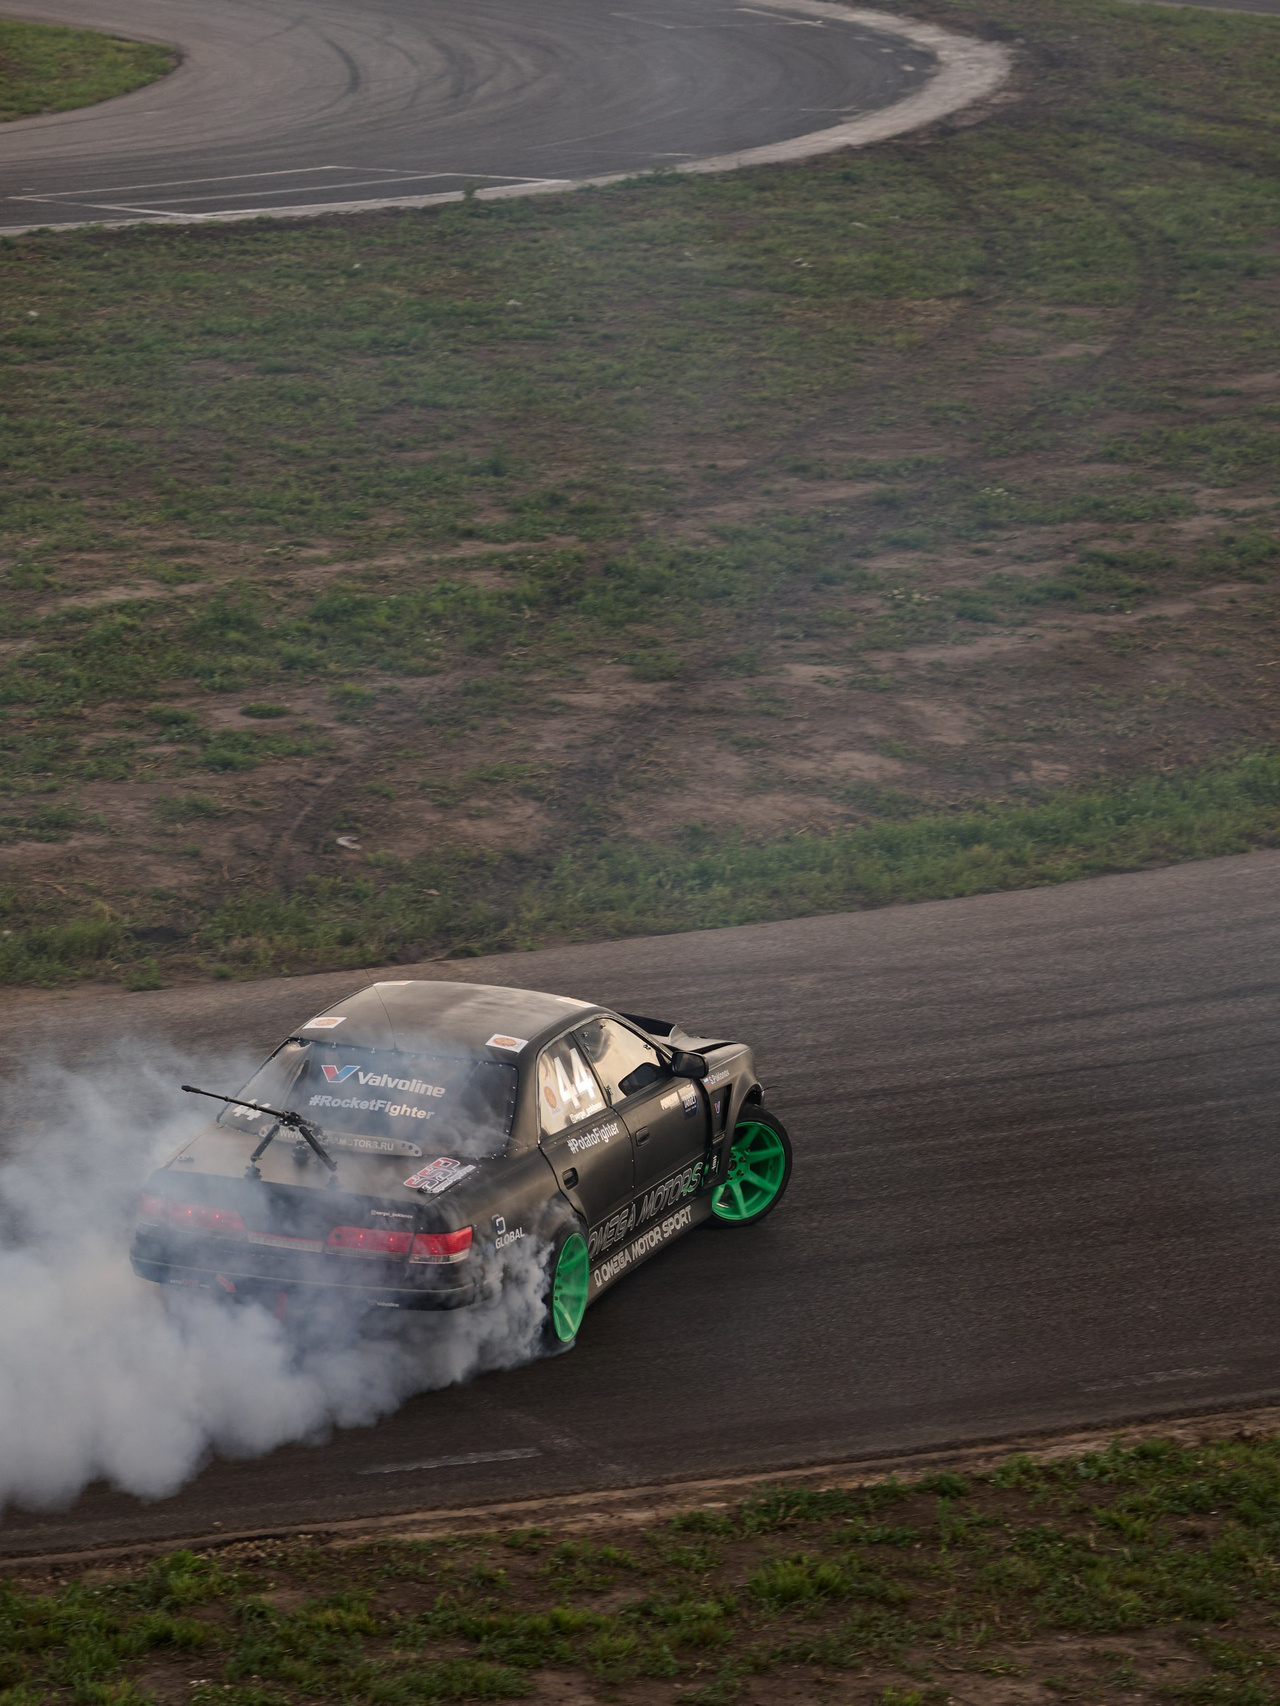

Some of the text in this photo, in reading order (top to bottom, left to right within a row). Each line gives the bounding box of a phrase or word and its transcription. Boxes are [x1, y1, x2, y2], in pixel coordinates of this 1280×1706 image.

[358, 1071, 446, 1098] Valvoline
[553, 1047, 596, 1110] 44
[308, 1094, 436, 1120] #RocketFighter
[567, 1122, 620, 1154] #PotatoFighter
[588, 1161, 703, 1259] OMEGA MOTORS
[495, 1226, 525, 1249] GLOBAL
[602, 1247, 632, 1282] OMEGA
[631, 1226, 663, 1261] MOTOR
[662, 1205, 692, 1239] SPORT
